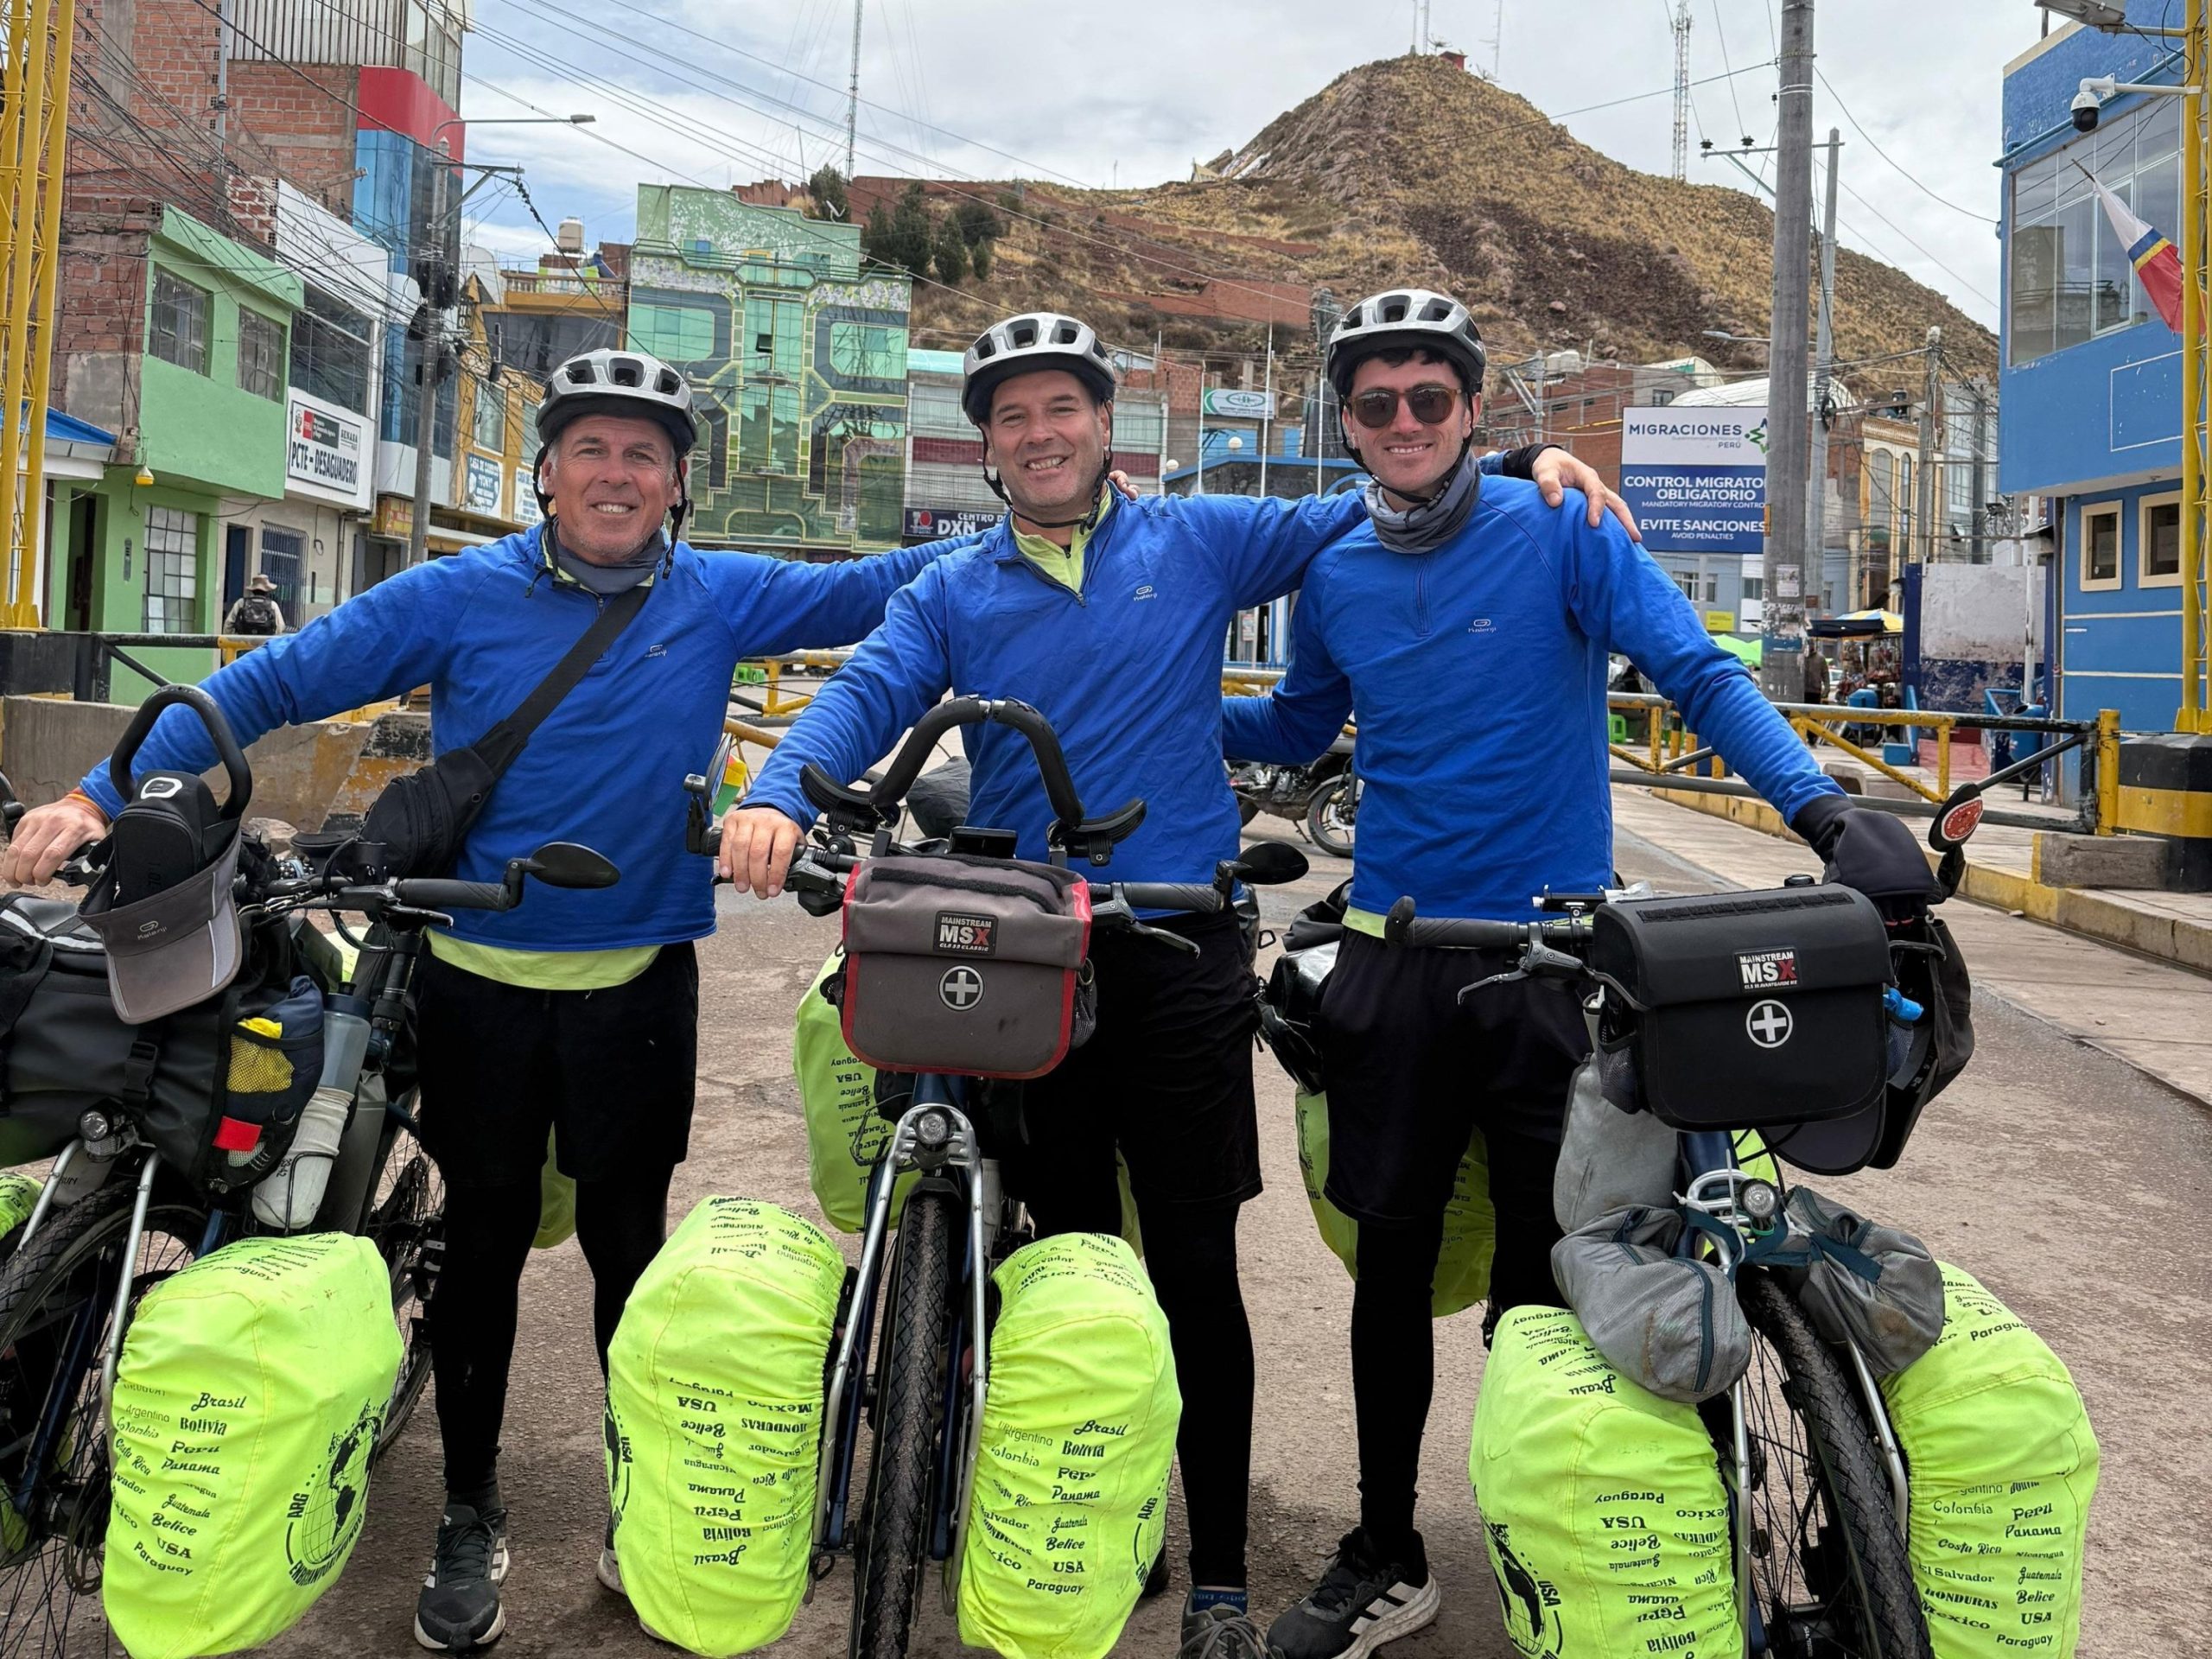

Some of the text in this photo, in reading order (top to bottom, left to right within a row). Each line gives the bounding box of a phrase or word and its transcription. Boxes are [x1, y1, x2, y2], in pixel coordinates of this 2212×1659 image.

[1629, 424, 1743, 435] MIGRACIONES
[291, 441, 308, 471] PCTE
[314, 448, 358, 486] DESAGUADERO
[1624, 476, 1764, 489] CONTROL MIGRATO
[1656, 488, 1757, 501] OBLIGATORIO
[958, 512, 995, 523] CENTRO
[1640, 518, 1765, 533] EVITE SANCIONES
[937, 519, 976, 536] DXN
[941, 916, 992, 928] MAINSTREAM
[939, 924, 991, 946] MSX
[1739, 951, 1795, 964] MAINSTREAM
[1740, 959, 1798, 984] MSX
[836, 1073, 863, 1084] USA
[190, 1392, 248, 1412] Brasil
[676, 1395, 717, 1413] USA
[125, 1404, 170, 1423] Argentina
[180, 1417, 228, 1436] Bolivia
[680, 1420, 726, 1438] Belice
[1073, 1419, 1128, 1436] Brasil
[171, 1440, 220, 1454] Peru
[620, 1436, 633, 1464] USA
[1061, 1440, 1105, 1458] Bolivia
[115, 1438, 151, 1477] Costa Rica
[161, 1457, 220, 1475] Panama
[113, 1471, 146, 1496] lvador
[752, 1471, 777, 1486] Rica
[687, 1483, 746, 1503] Panama
[1051, 1485, 1100, 1502] Panama
[1594, 1491, 1665, 1505] Paraguay
[1958, 1484, 2003, 1496] gentina
[161, 1494, 211, 1519] Guatemala
[286, 1492, 310, 1519] ARG
[693, 1506, 742, 1522] Peru
[1137, 1496, 1158, 1521] ARG
[1933, 1499, 1993, 1515] Colombia
[2011, 1502, 2053, 1522] Peru
[151, 1512, 197, 1536] Belice
[762, 1509, 802, 1532] gentina
[1051, 1514, 1088, 1534] Guatemala
[1600, 1516, 1647, 1529] USA
[1674, 1529, 1724, 1544] NDURAS
[2005, 1524, 2063, 1539] Panama
[156, 1535, 193, 1560] USA
[1045, 1536, 1085, 1551] Belice
[1610, 1534, 1662, 1552] Belice
[1938, 1538, 2002, 1556] Costa Rica
[133, 1541, 194, 1576] Paraguay
[693, 1545, 747, 1566] Brasil
[1608, 1553, 1661, 1573] Guatemala
[1053, 1560, 1085, 1574] USA
[1934, 1567, 1995, 1583] Salvador
[2018, 1566, 2062, 1585] Guatemala
[1026, 1578, 1085, 1596] Paraguay
[1537, 1580, 1562, 1608] USA
[1627, 1594, 1682, 1605] anama
[1924, 1587, 1999, 1610] HONDURAS
[2015, 1589, 2055, 1605] Belice
[2021, 1611, 2052, 1625] USA
[1646, 1630, 1697, 1654] Bolivia
[1996, 1634, 2053, 1650] Paraguay
